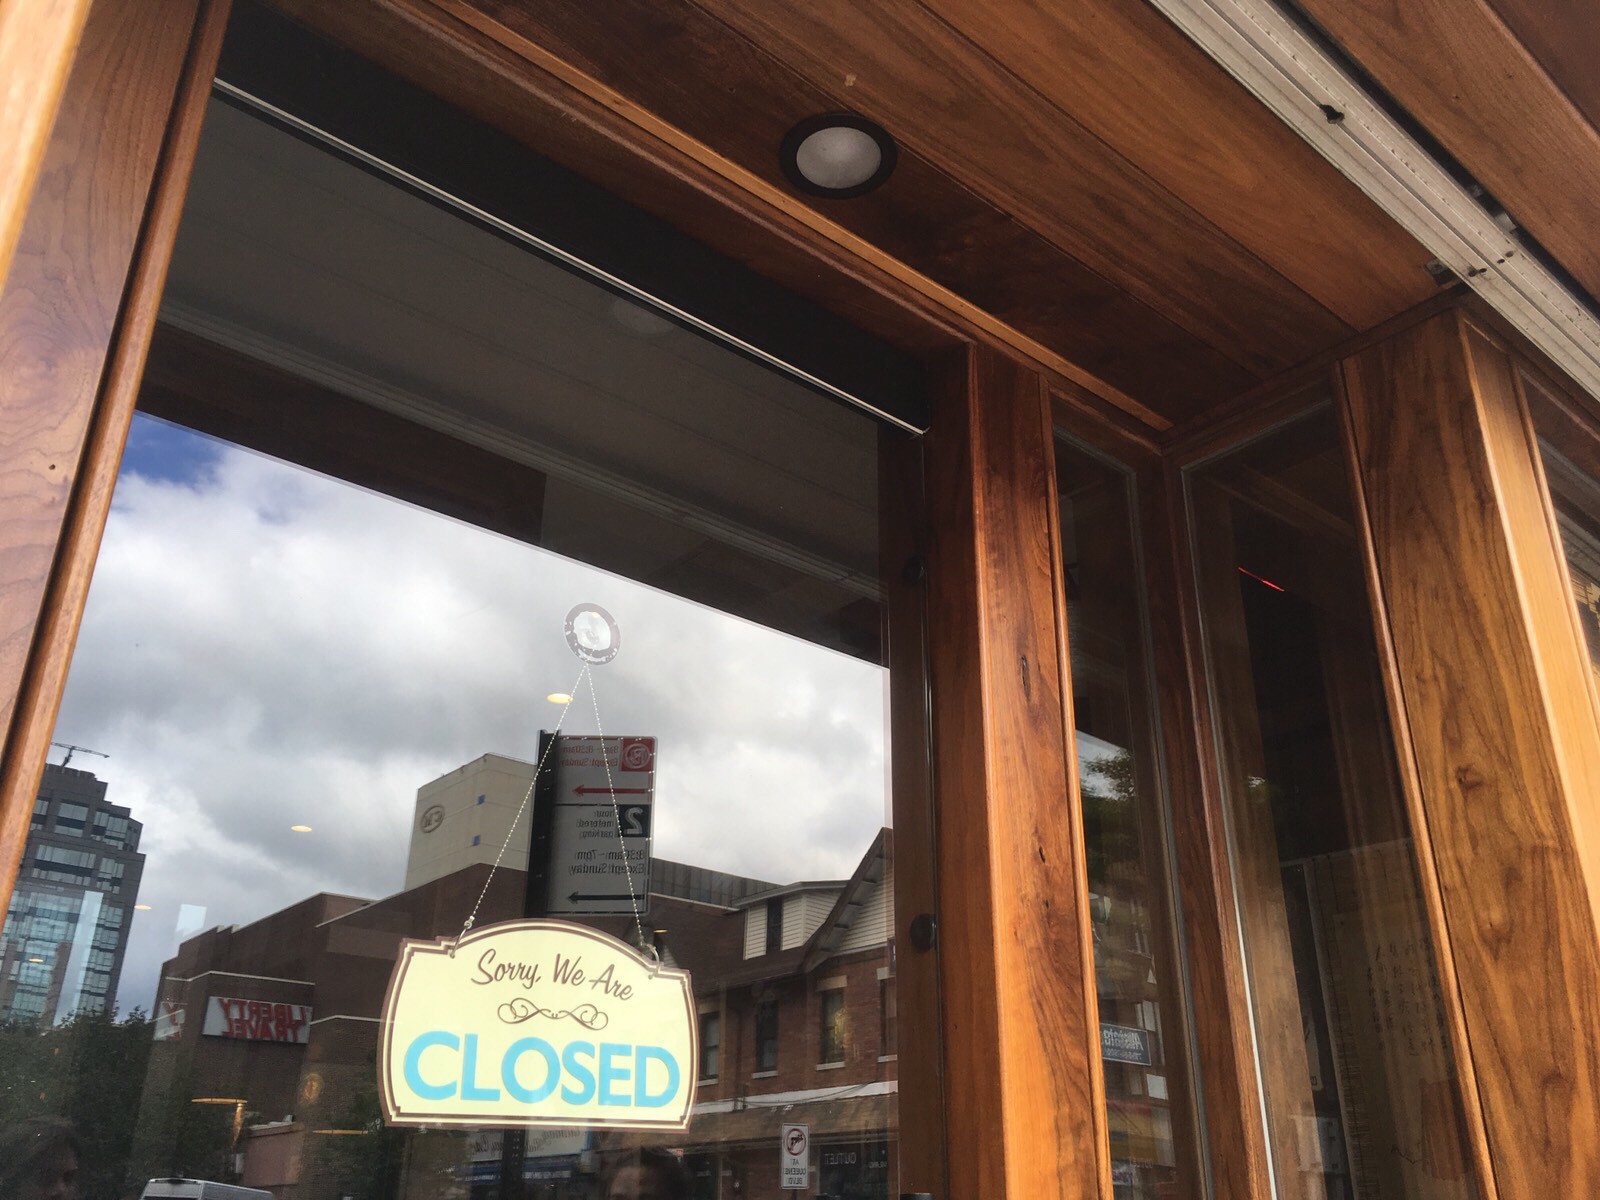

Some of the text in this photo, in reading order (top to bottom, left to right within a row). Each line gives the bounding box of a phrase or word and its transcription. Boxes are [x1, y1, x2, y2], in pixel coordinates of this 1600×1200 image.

[552, 953, 586, 987] We
[589, 964, 634, 1001] Are
[403, 1030, 680, 1107] CLOSED
